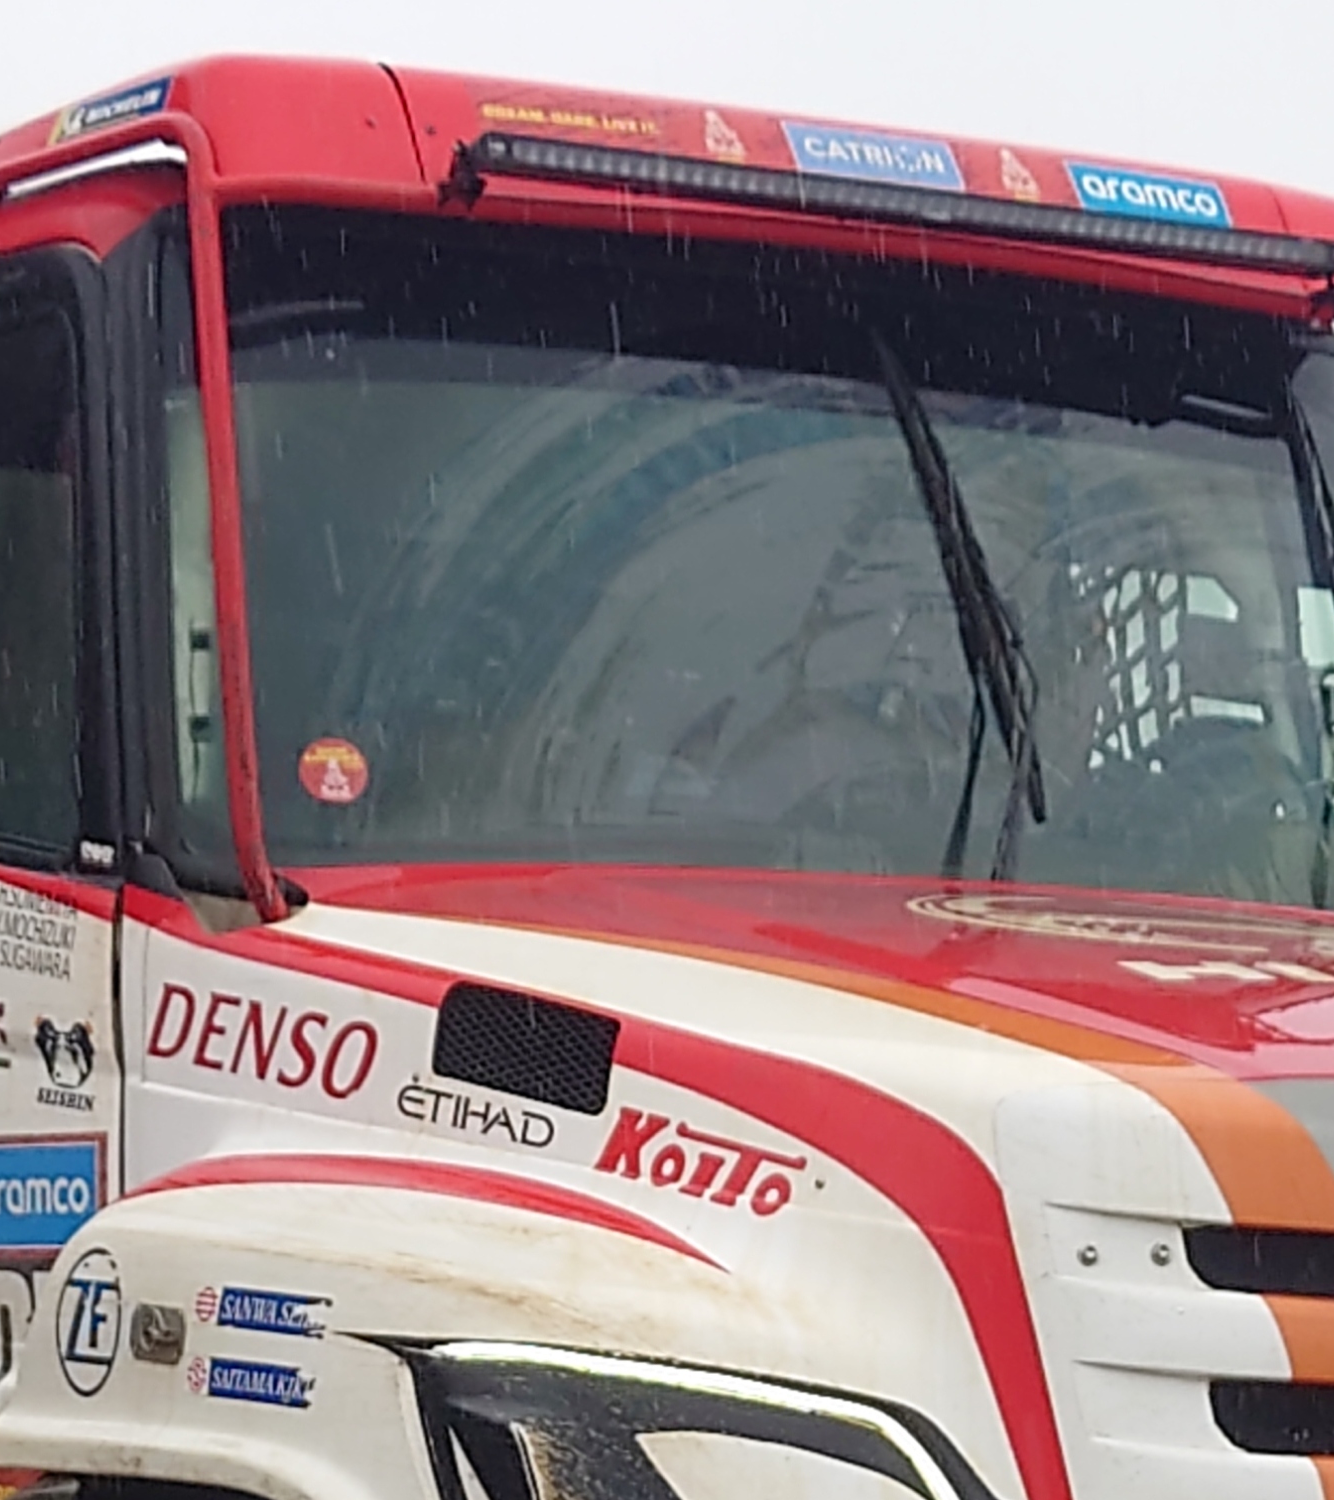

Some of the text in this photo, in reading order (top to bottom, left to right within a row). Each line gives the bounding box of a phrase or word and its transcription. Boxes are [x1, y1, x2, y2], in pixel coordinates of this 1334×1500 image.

[1081, 173, 1219, 217] aramco
[147, 982, 378, 1099] DENSO
[65, 1277, 117, 1365] ZF
[221, 1292, 276, 1327] SANWA
[211, 1365, 274, 1393] SAITAMA
